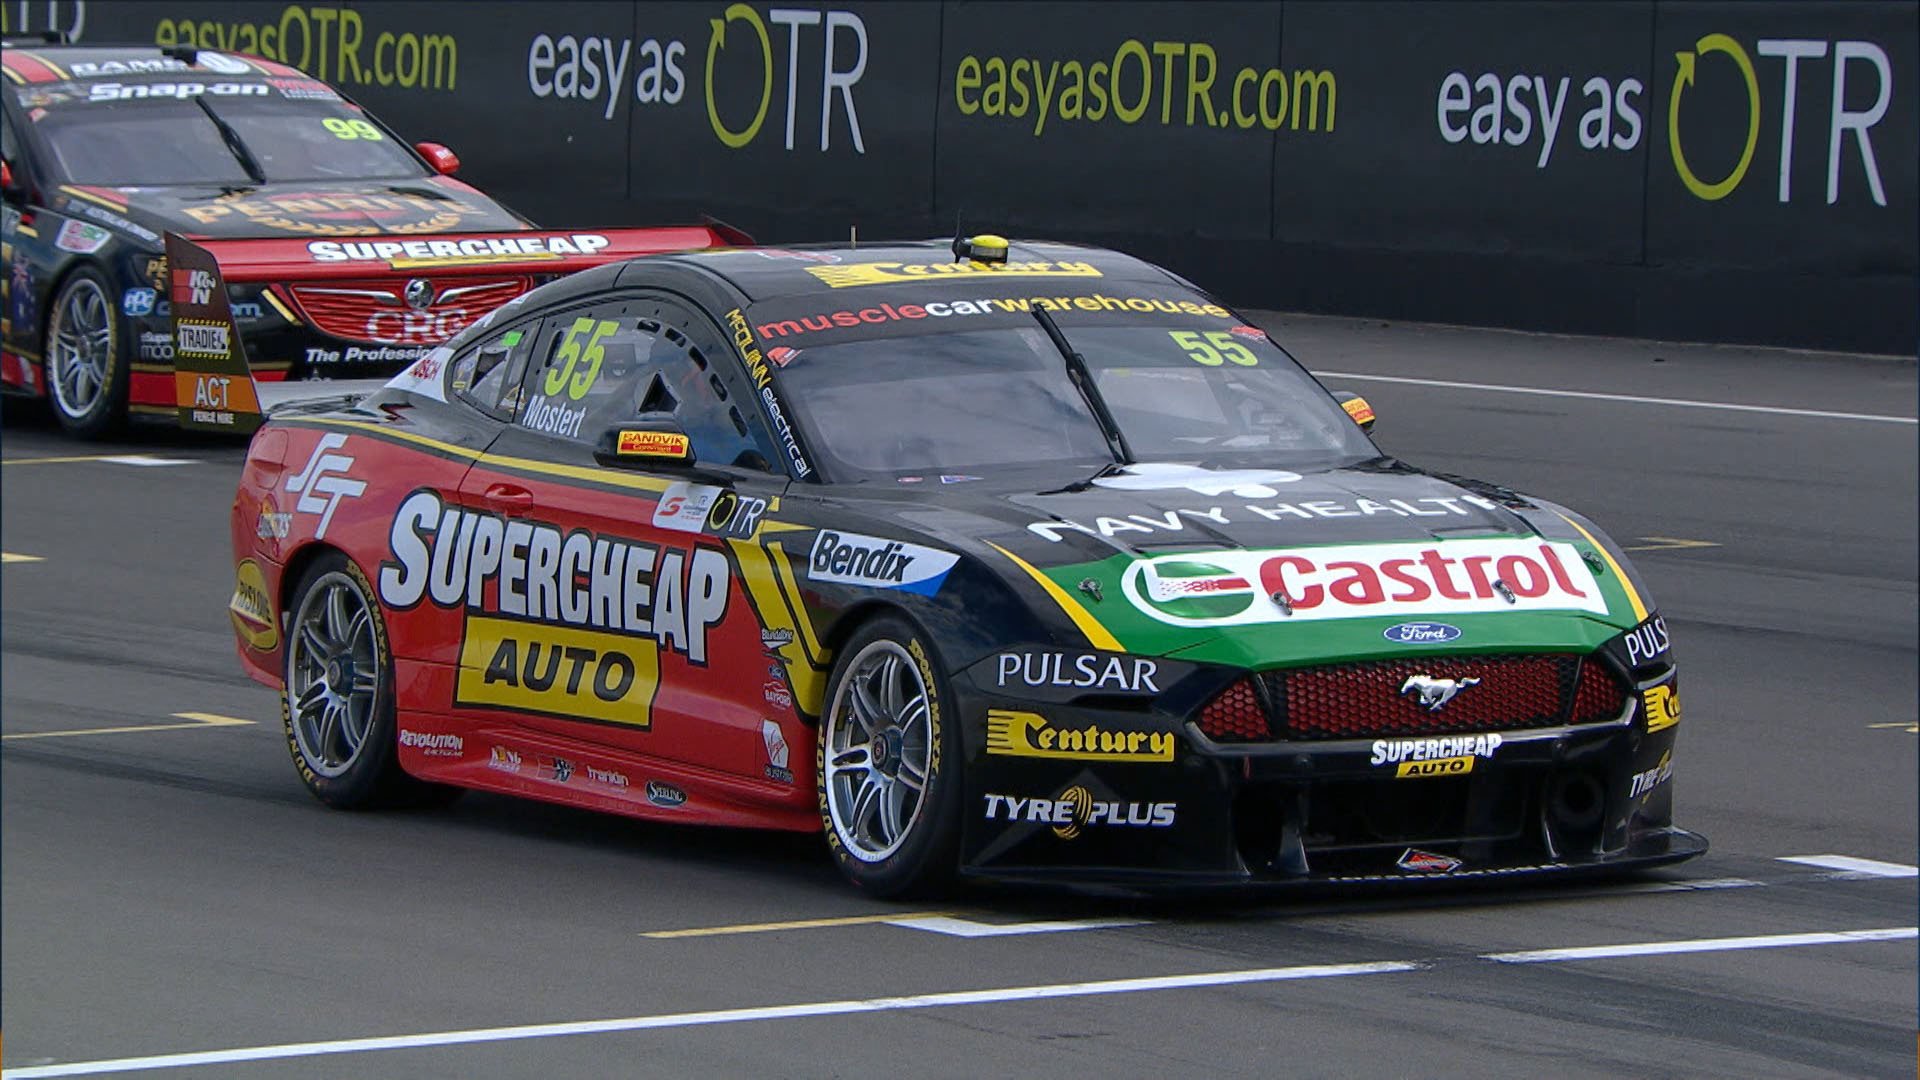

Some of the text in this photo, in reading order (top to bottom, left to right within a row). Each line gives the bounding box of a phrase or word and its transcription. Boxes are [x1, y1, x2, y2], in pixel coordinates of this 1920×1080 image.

[89, 83, 269, 101] Snap-on
[527, 3, 868, 154] easy as OTR
[954, 39, 1337, 136] easyasOTR.com
[322, 118, 382, 140] 99
[1436, 33, 1894, 207] easy as OTR
[307, 235, 609, 262] SUPERCHEAP
[757, 295, 1232, 340] musclecarwarehouse
[182, 328, 217, 349] TRADIE
[306, 349, 340, 363] The
[544, 317, 620, 400] 55
[1168, 331, 1258, 366] 55
[196, 377, 231, 408] ACT
[522, 395, 587, 438] Mostert
[762, 387, 811, 478] electrical
[623, 433, 683, 446] SANDVIK
[709, 494, 767, 535] OTR
[1027, 505, 1231, 542] NAVY
[379, 490, 731, 664] SUPERCHEAP
[813, 531, 915, 582] Bendix
[1257, 545, 1587, 610] Castrol
[1400, 625, 1448, 640] Ford
[1624, 616, 1669, 666] PULS
[483, 637, 635, 702] AUTO
[997, 652, 1160, 693] PULSAR
[400, 729, 464, 750] REVOLUTION
[986, 708, 1175, 762] Century
[1371, 733, 1503, 765] SUPERCHEAP
[1405, 759, 1465, 776] AUTO
